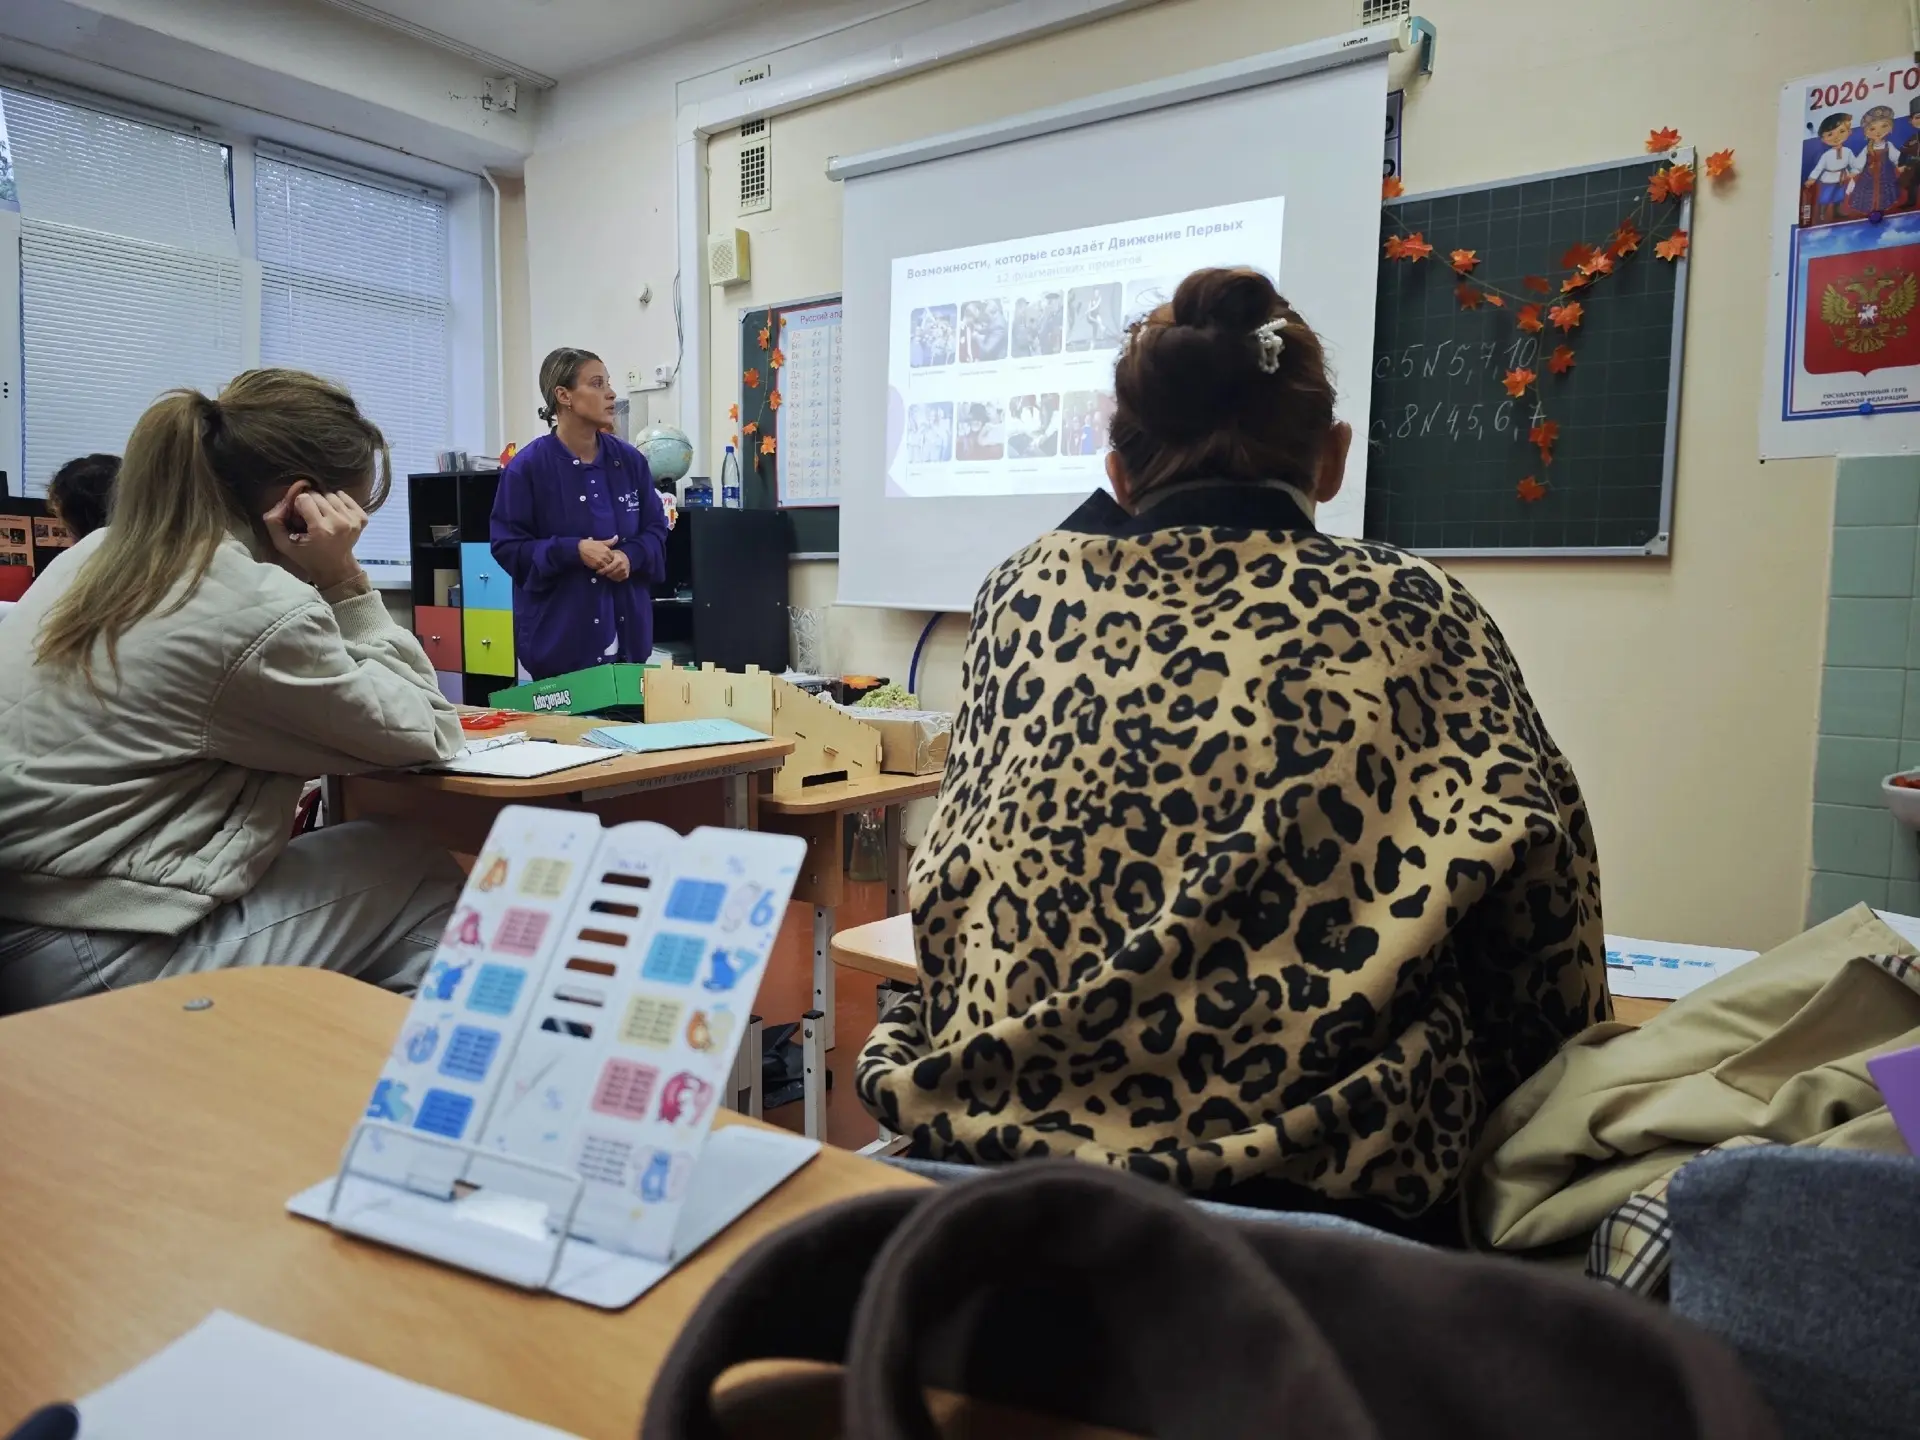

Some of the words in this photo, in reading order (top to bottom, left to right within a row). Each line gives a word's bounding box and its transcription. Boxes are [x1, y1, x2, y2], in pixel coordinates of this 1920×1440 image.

[907, 259, 990, 279] Возможности,
[995, 250, 1047, 266] которые
[1051, 240, 1104, 258] создаёт
[1108, 230, 1181, 251] Движение
[1186, 219, 1244, 238] Первых
[1012, 263, 1085, 283] флагманских
[1088, 254, 1142, 272] проектов
[1821, 397, 1865, 406] РОССИЙСКОЙ
[1866, 394, 1908, 402] ФЕДЕРАЦИИ
[1823, 388, 1889, 399] ГОСУДАРСТВЕННЫЙ
[1891, 386, 1907, 394] ГЕРБ
